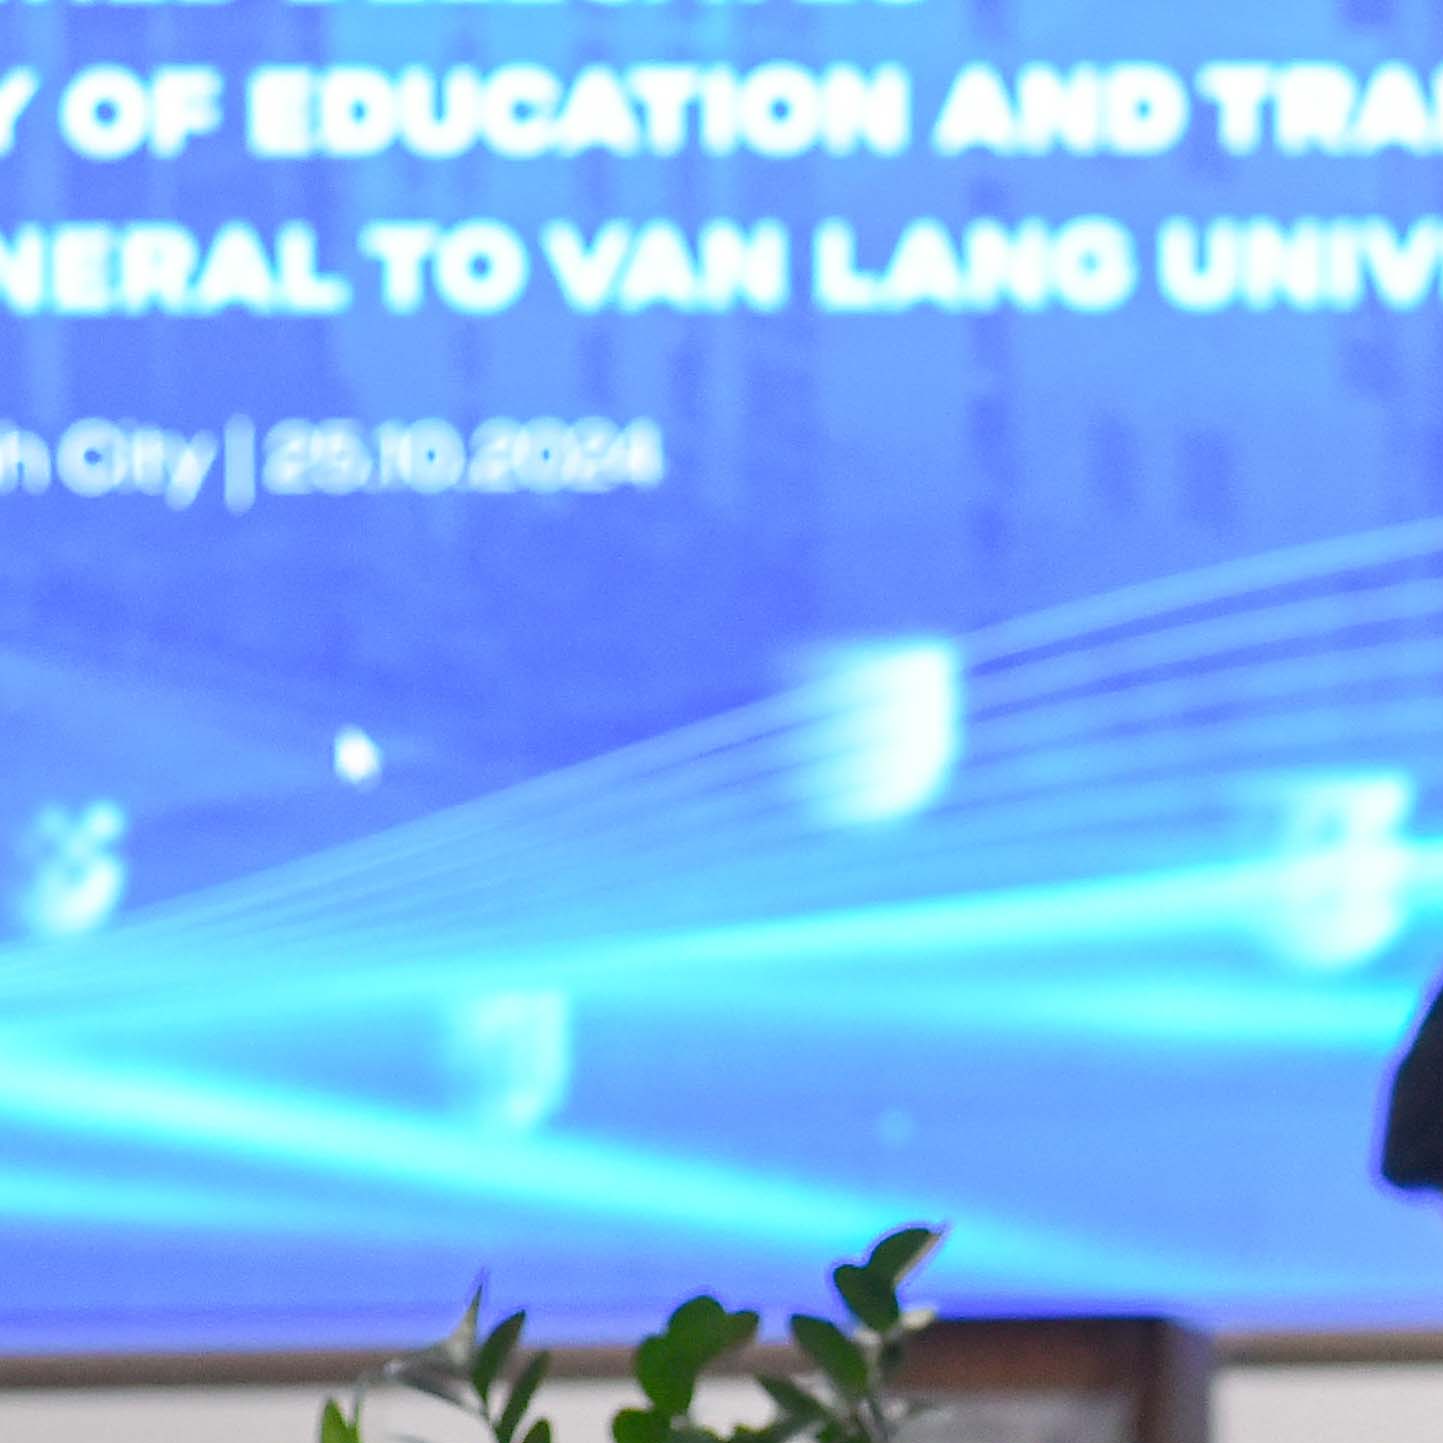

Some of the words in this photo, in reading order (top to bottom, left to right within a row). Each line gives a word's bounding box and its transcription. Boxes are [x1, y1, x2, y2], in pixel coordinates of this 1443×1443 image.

[59, 62, 222, 160] OF
[246, 62, 912, 158] EDUCATION
[932, 60, 1190, 157] AND
[360, 219, 529, 314] TO
[542, 217, 789, 313] VAN
[813, 216, 1137, 312] LANG
[57, 416, 217, 511] City
